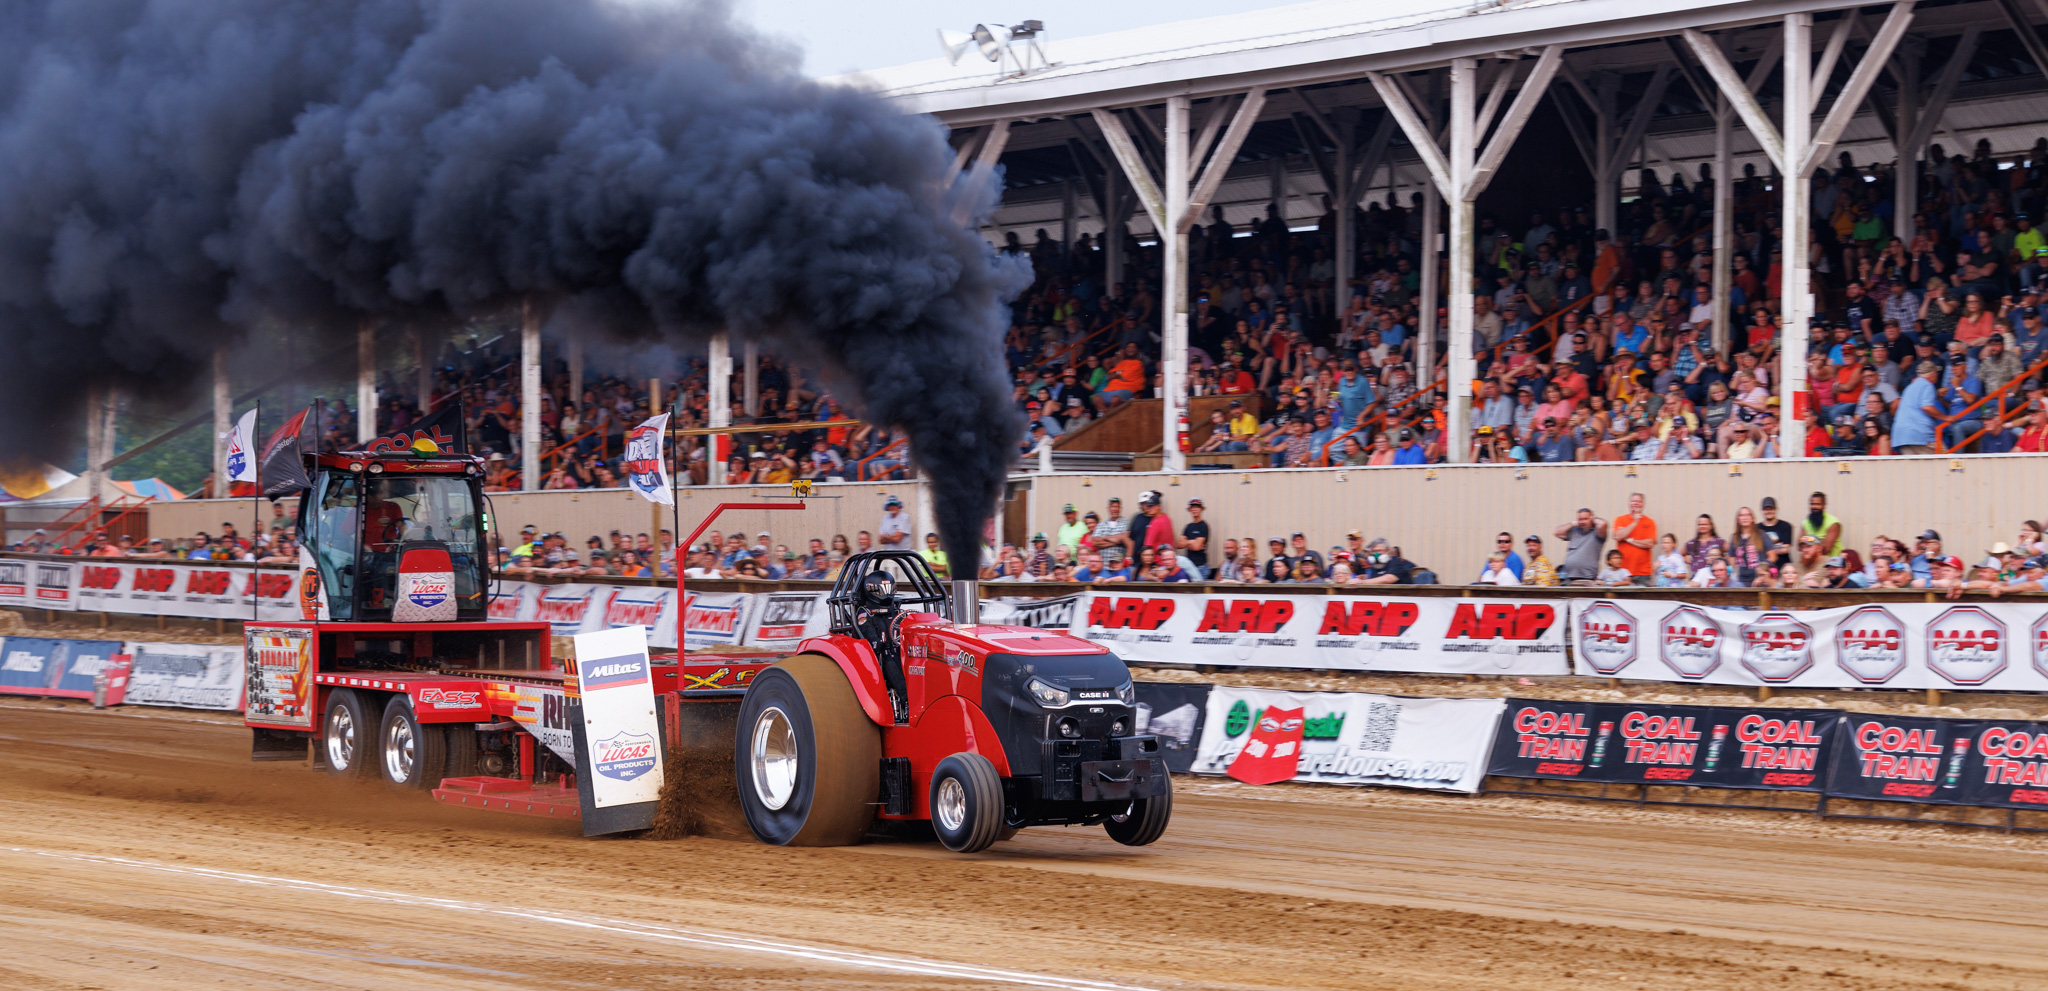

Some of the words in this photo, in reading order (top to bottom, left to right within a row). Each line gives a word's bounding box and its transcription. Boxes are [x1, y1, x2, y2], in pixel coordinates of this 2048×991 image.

[413, 585, 446, 593] LUCAS
[1087, 597, 1175, 630] ARP
[1195, 600, 1294, 633] ARP
[1318, 601, 1419, 637] ARP
[1445, 604, 1554, 639] ARP
[588, 662, 642, 679] Mitas
[958, 650, 975, 668] 400
[419, 688, 481, 704] FASS
[1513, 707, 1591, 737] COAL
[1620, 711, 1701, 740] COAL
[1735, 714, 1822, 744] COAL
[543, 732, 562, 747] BORN
[563, 735, 572, 749] TO
[1517, 734, 1588, 761] TRAIN
[1855, 721, 1944, 755] COAL
[1977, 727, 2048, 759] COA
[601, 744, 651, 762] LUCAS
[613, 759, 654, 770] PRODUCTS
[1623, 739, 1698, 765] TRAIN
[1740, 742, 1819, 770] TRAIN
[1535, 762, 1585, 776] ENERGY
[1643, 767, 1695, 780] ENERGY
[1762, 772, 1816, 786] ENERGY
[1859, 752, 1940, 781] TRAIN
[1983, 756, 2048, 787] TRAI
[1882, 782, 1937, 797] ENERGY
